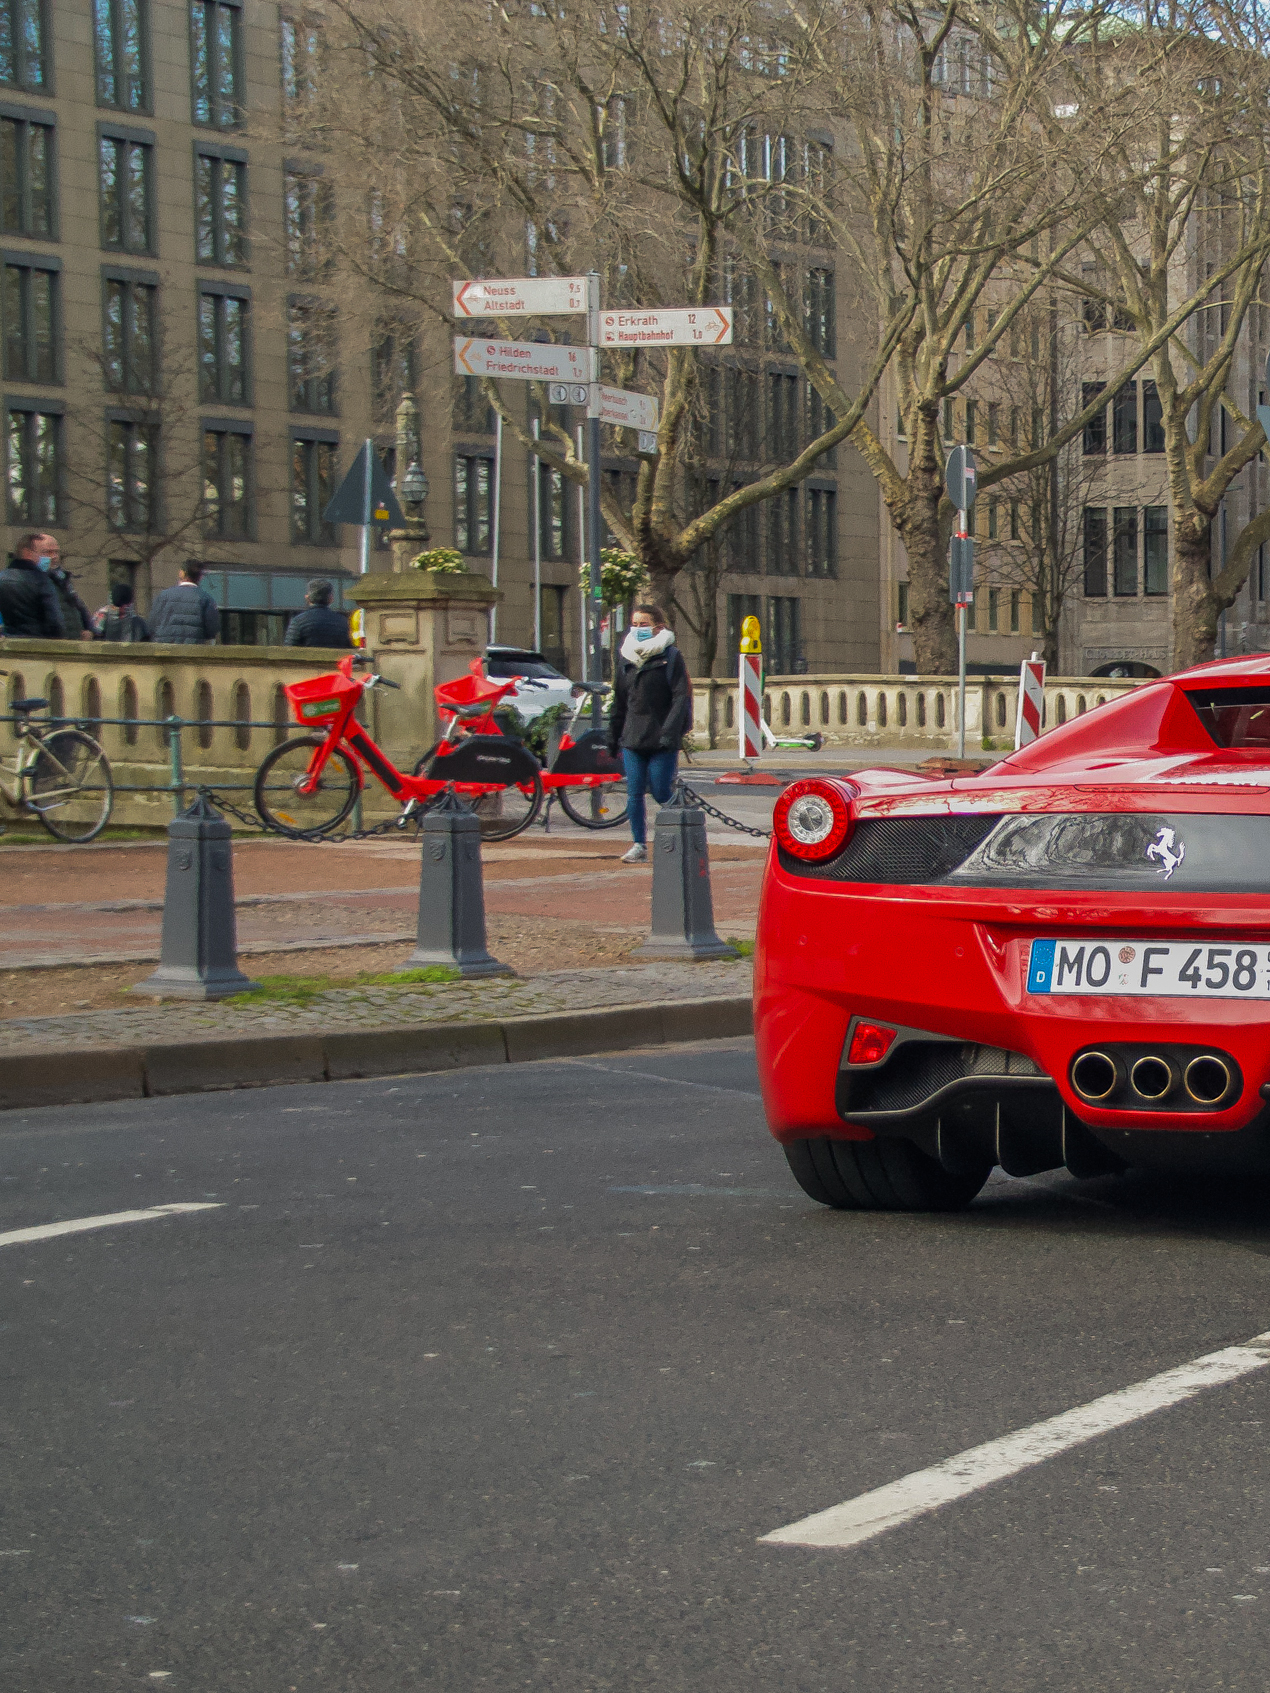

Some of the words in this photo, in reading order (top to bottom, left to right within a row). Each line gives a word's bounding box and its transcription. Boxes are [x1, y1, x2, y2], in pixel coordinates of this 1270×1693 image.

[483, 286, 516, 296] Neuss
[484, 300, 525, 310] Altstadt
[618, 315, 658, 326] Erkrath
[687, 313, 696, 324] 12
[618, 330, 674, 343] Hauptbahnhof
[499, 346, 531, 358] Hilden
[568, 351, 577, 362] 16
[486, 360, 559, 376] Friedrichstadt
[1056, 945, 1111, 988] MO
[1140, 947, 1170, 988] F
[1178, 948, 1258, 991] 458
[1036, 971, 1046, 983] D
